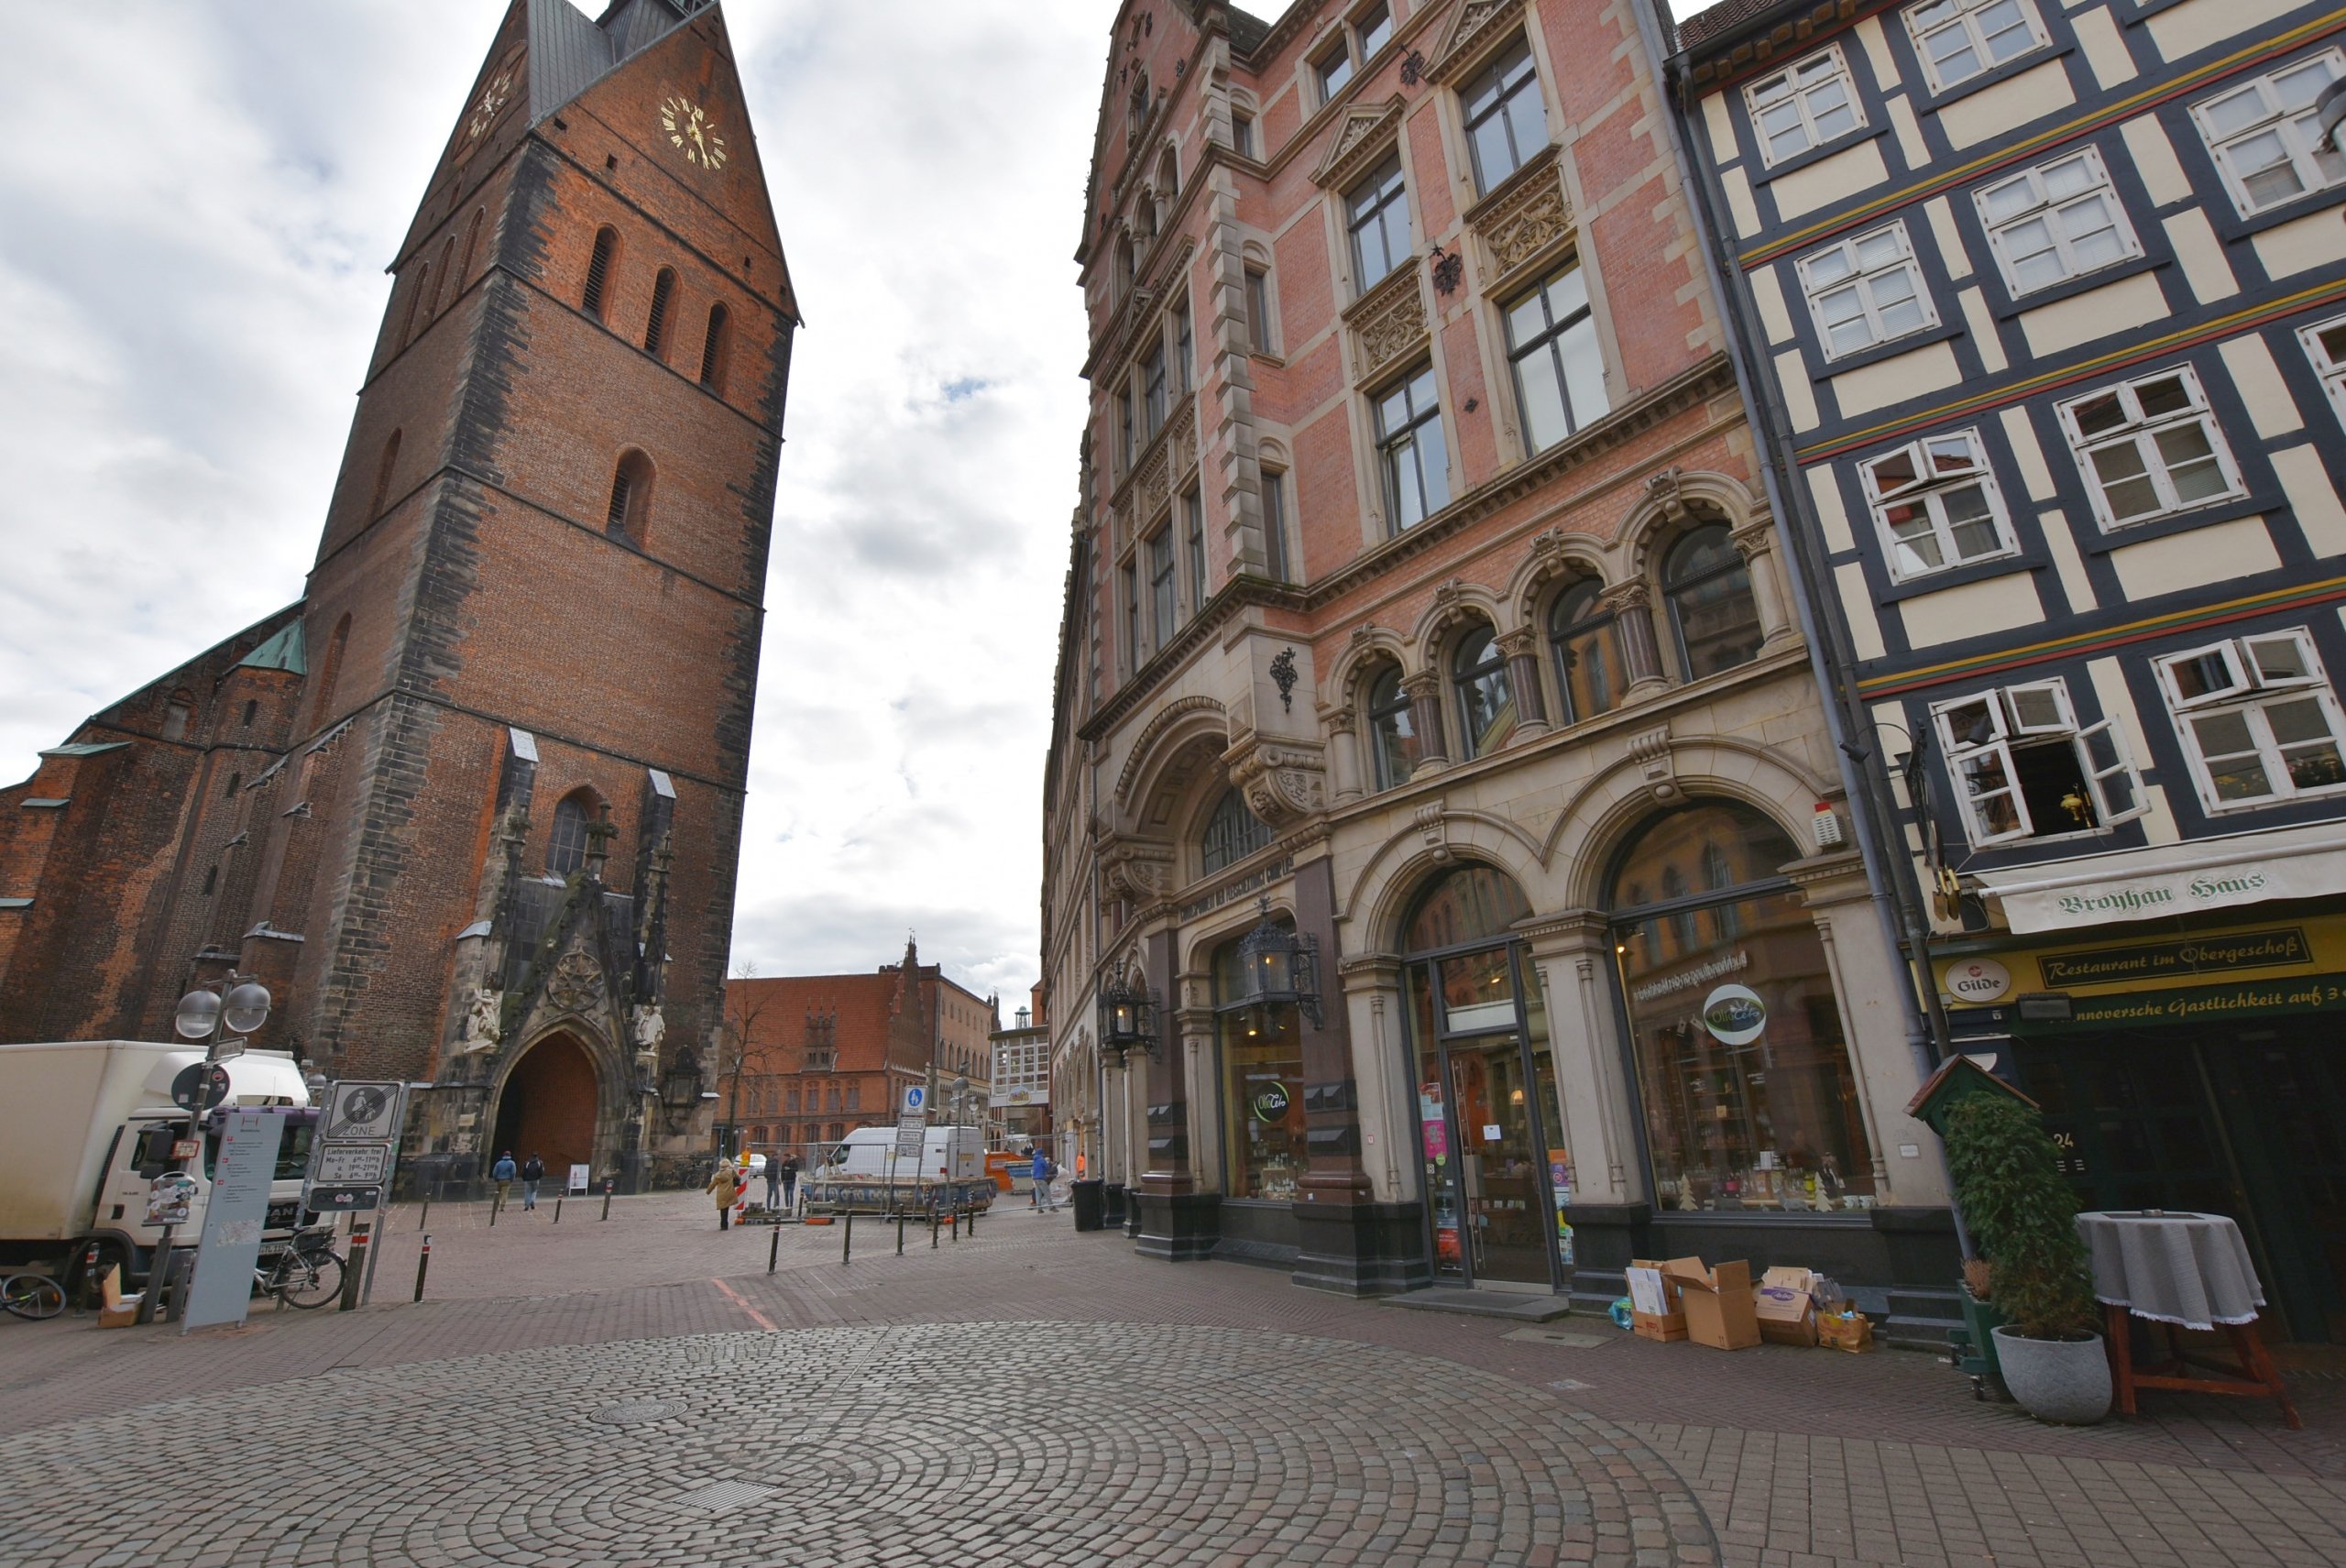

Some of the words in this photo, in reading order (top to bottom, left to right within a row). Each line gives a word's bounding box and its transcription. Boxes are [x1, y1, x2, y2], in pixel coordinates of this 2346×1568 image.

[2059, 886, 2173, 914] Broyhan
[2190, 872, 2266, 899] Haus
[2047, 956, 2148, 981] Restaurant
[2154, 954, 2175, 967] im
[2179, 936, 2298, 963] Obergeschoß
[1957, 978, 2001, 992] Gilde
[2075, 1000, 2164, 1022] nnoversche
[2167, 991, 2283, 1016] Gastlichkeit
[2288, 985, 2321, 1006] auf
[2328, 987, 2339, 1000] 3
[343, 1125, 377, 1136] ZONE
[2054, 1133, 2074, 1147] 24
[327, 1147, 368, 1156] Lieferverkehr
[325, 1156, 345, 1164] Mo-Fr
